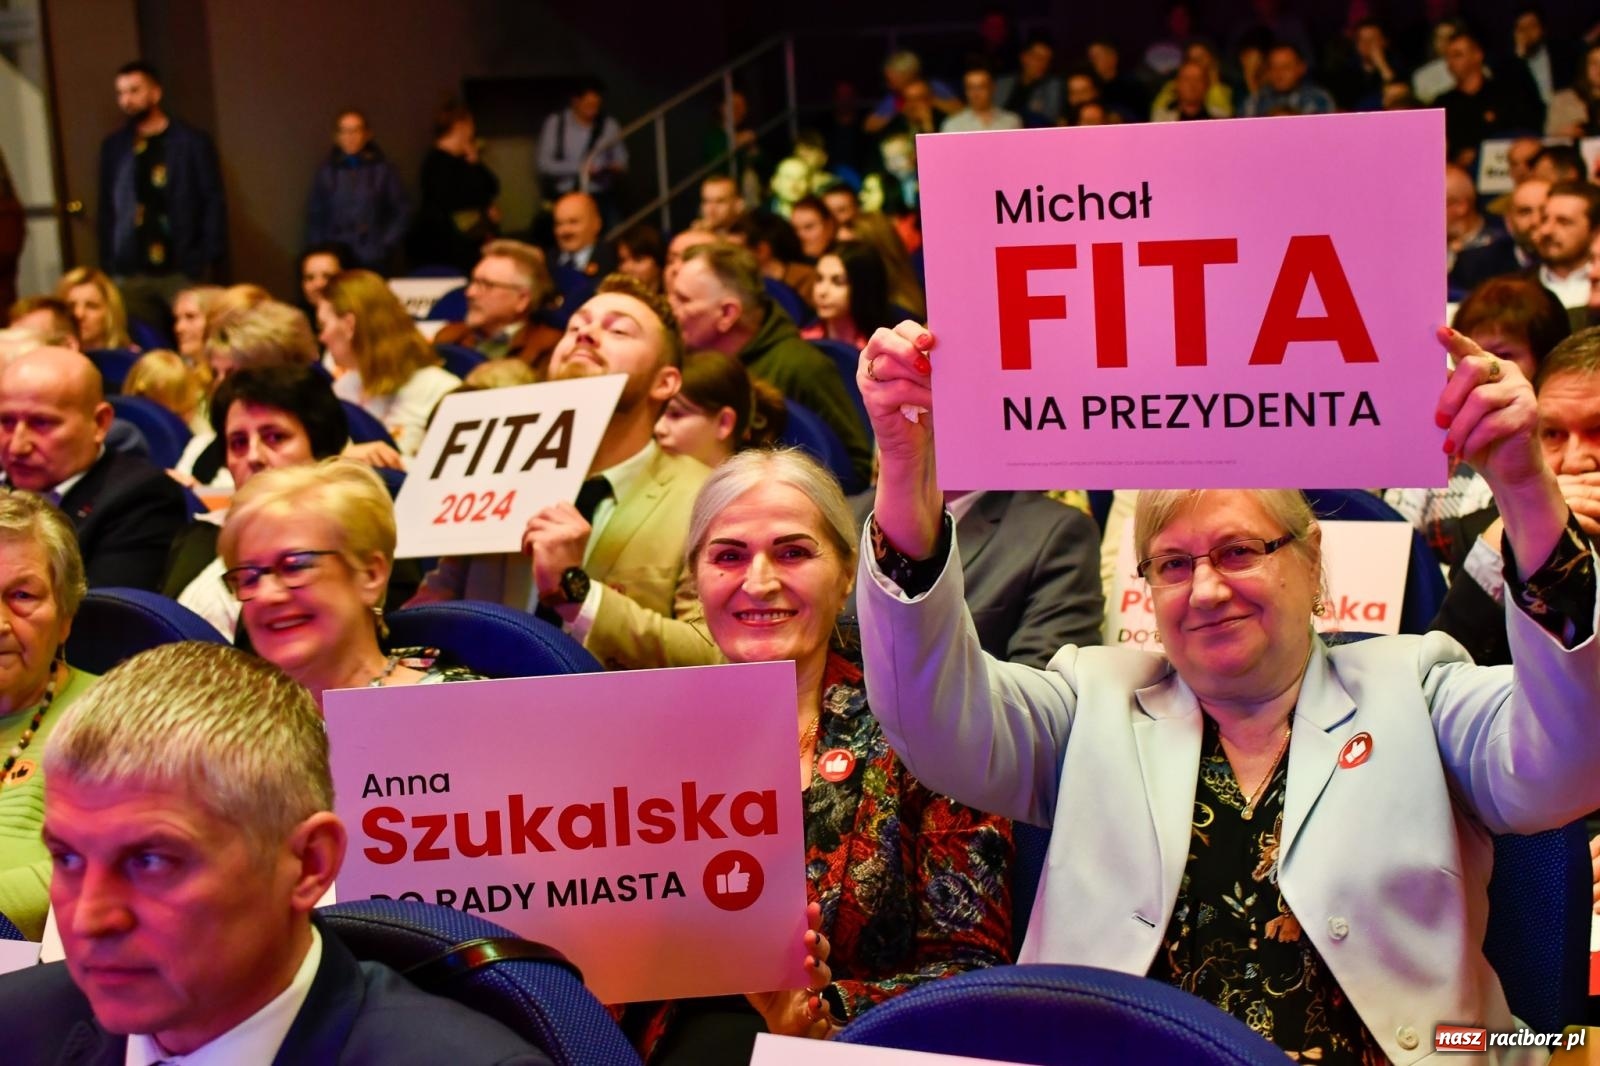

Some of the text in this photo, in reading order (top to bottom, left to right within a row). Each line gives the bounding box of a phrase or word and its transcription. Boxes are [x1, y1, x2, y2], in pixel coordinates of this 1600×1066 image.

[995, 181, 1152, 224] Michał
[995, 234, 1380, 370] FITA
[1002, 391, 1381, 431] NA PREZYDENTA
[430, 409, 576, 480] FITA
[433, 490, 517, 525] 2024
[361, 773, 451, 798] Anna
[361, 781, 779, 865] Szukalska
[436, 871, 686, 913] RADY MIASTA
